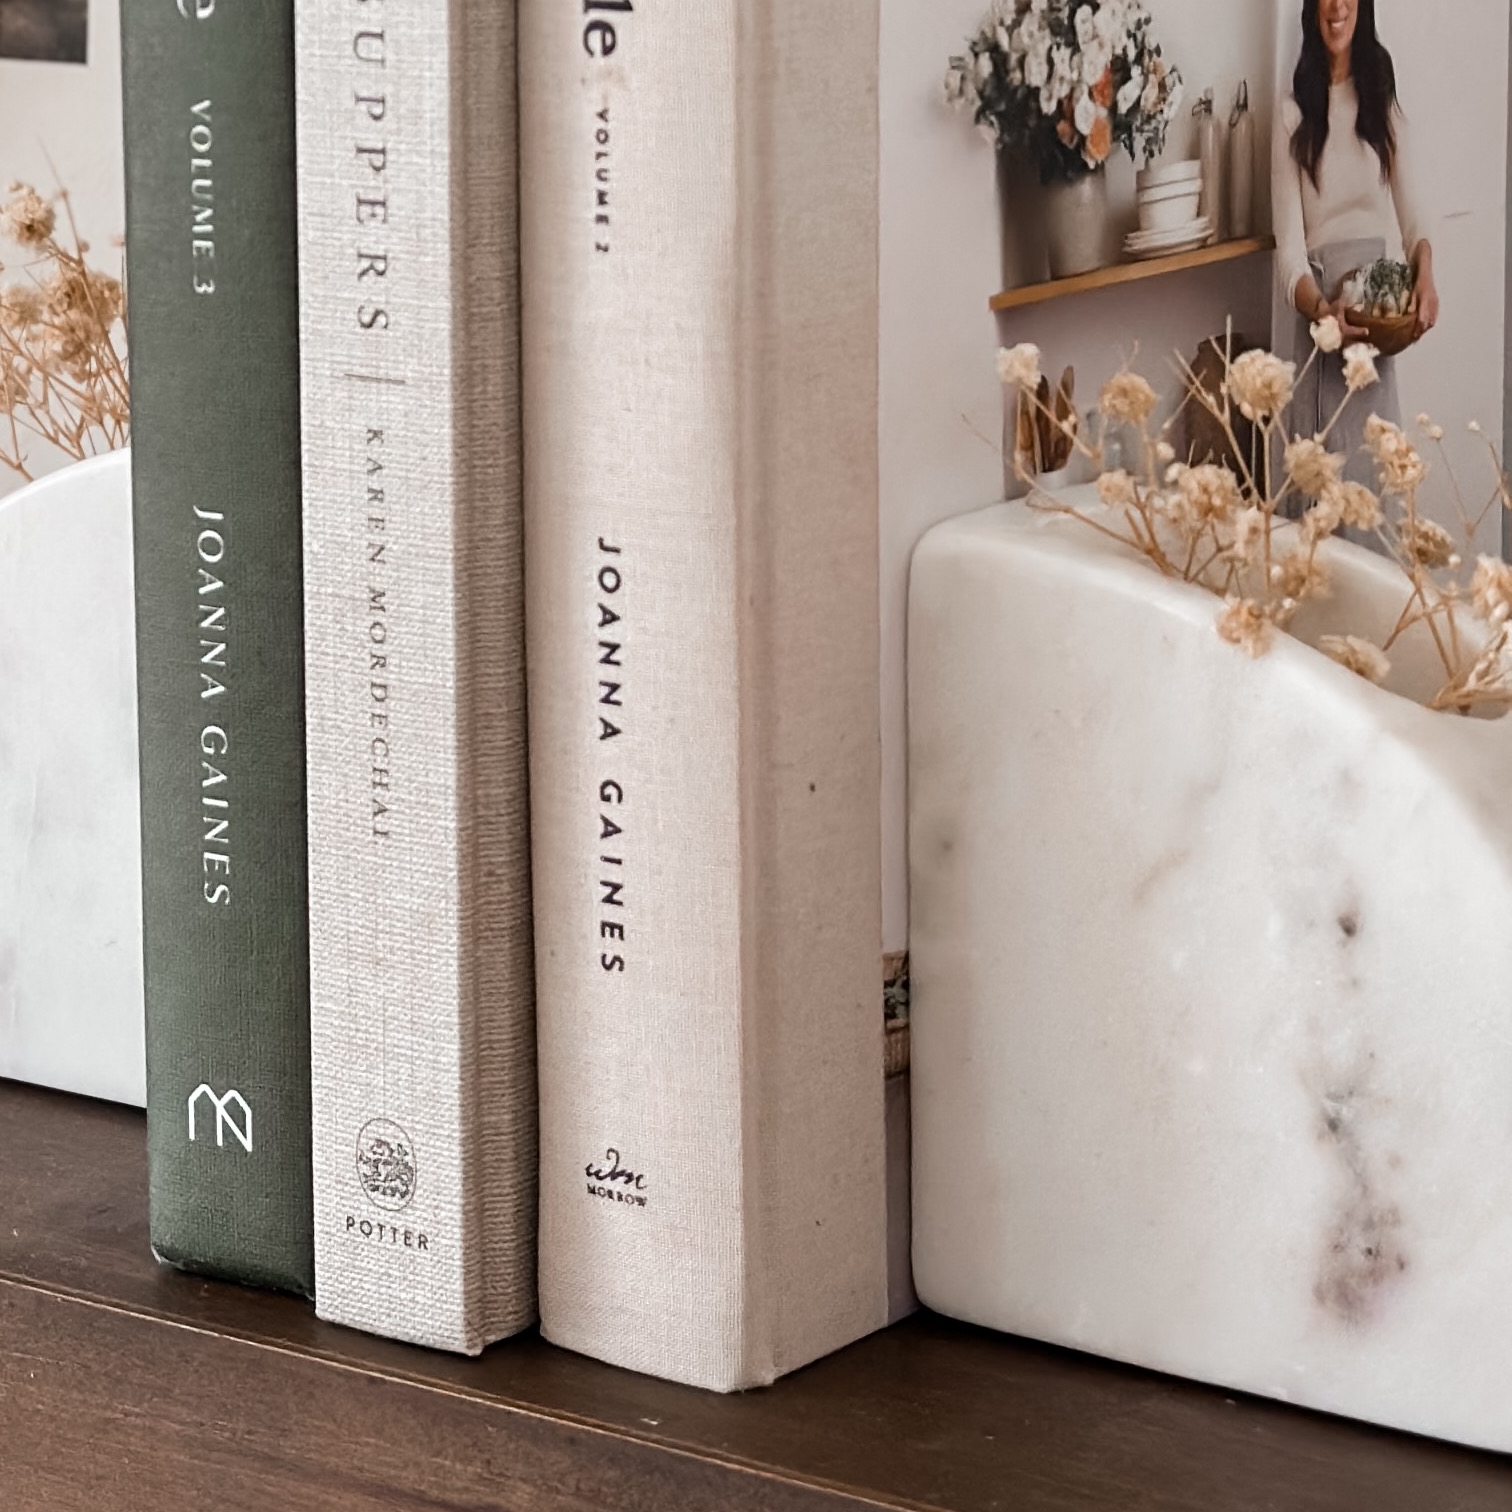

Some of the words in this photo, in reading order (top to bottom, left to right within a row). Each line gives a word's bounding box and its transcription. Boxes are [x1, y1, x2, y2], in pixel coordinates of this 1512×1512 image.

[188, 99, 215, 258] VOLUME
[594, 108, 611, 226] VOLUME
[192, 276, 216, 296] 3
[594, 243, 609, 254] 2
[366, 427, 388, 568] KAREN
[193, 505, 226, 702] JOANNA
[596, 536, 622, 743] JOANNA
[368, 585, 391, 843] MORDECHAI
[200, 726, 231, 907] GAINES
[599, 780, 626, 976] GAINES
[346, 1216, 429, 1250] POTTER
[587, 1183, 647, 1208] MORROW
